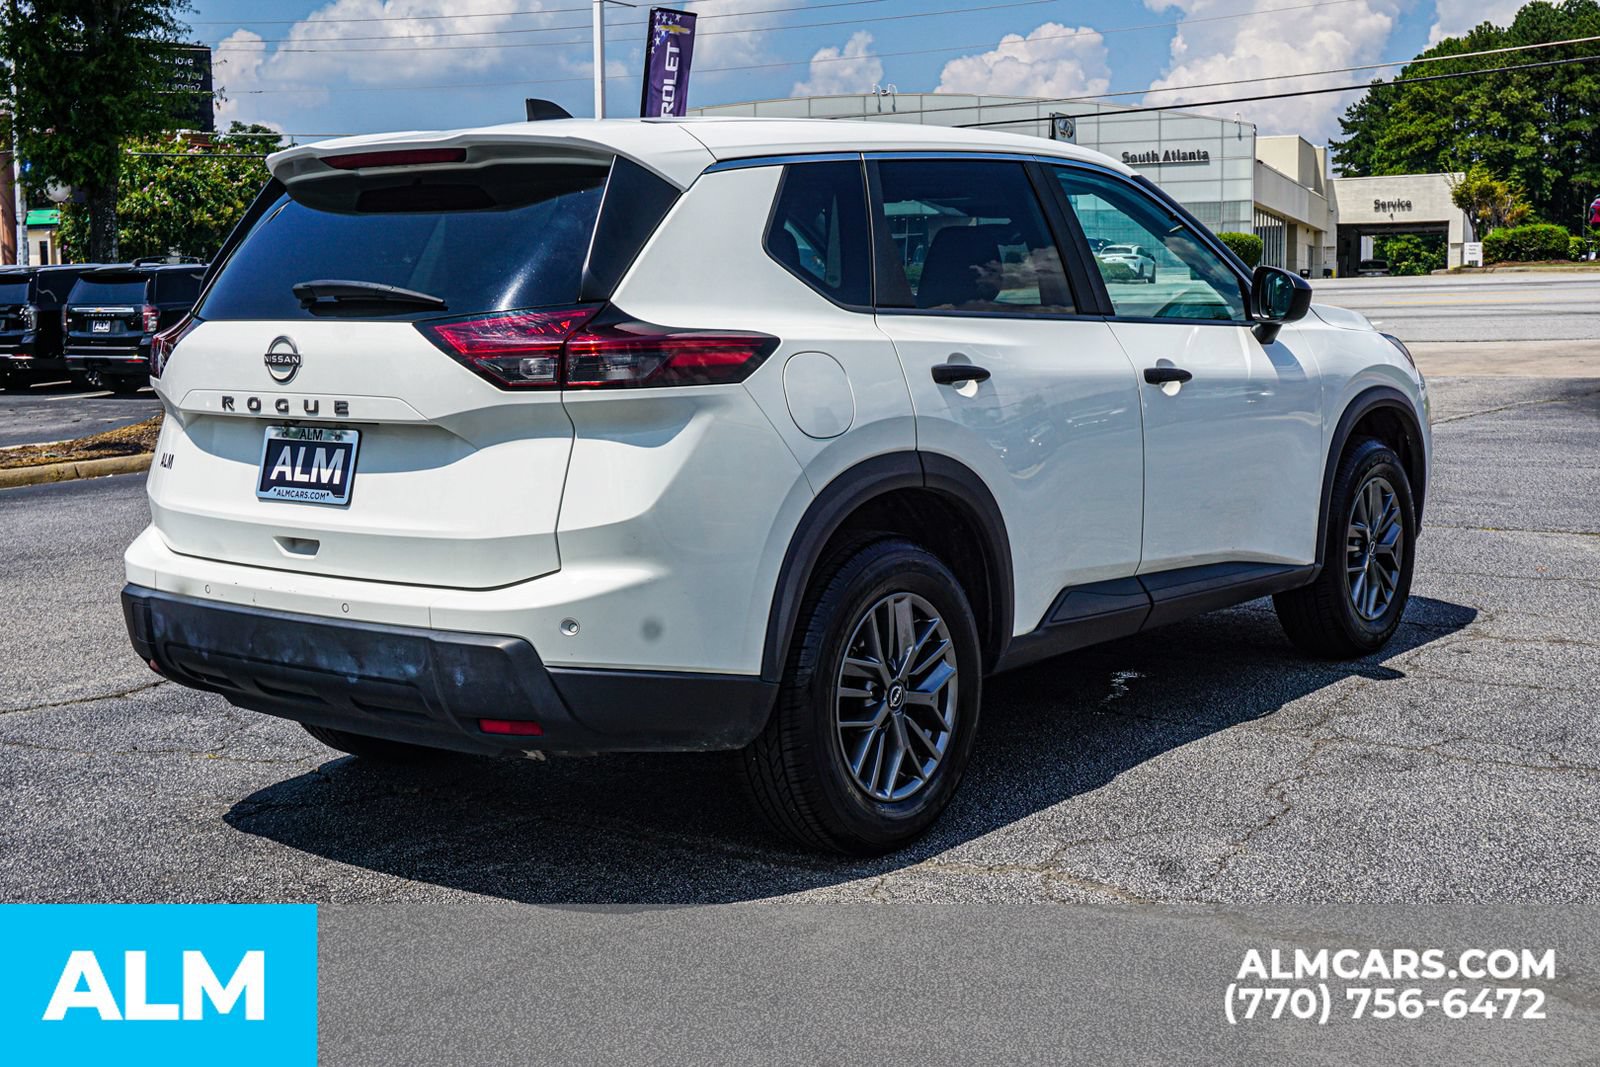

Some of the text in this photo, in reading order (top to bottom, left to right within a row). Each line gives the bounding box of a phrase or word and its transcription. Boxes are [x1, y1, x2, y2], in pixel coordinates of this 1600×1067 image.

[1121, 149, 1210, 163] South Atlanta
[1373, 198, 1412, 211] Service
[264, 355, 300, 364] NISSAN
[221, 395, 350, 415] ROGUE
[300, 428, 323, 440] ALM
[160, 453, 174, 469] ALM
[270, 445, 346, 485] ALM
[276, 489, 326, 500] ALMCARS.COM
